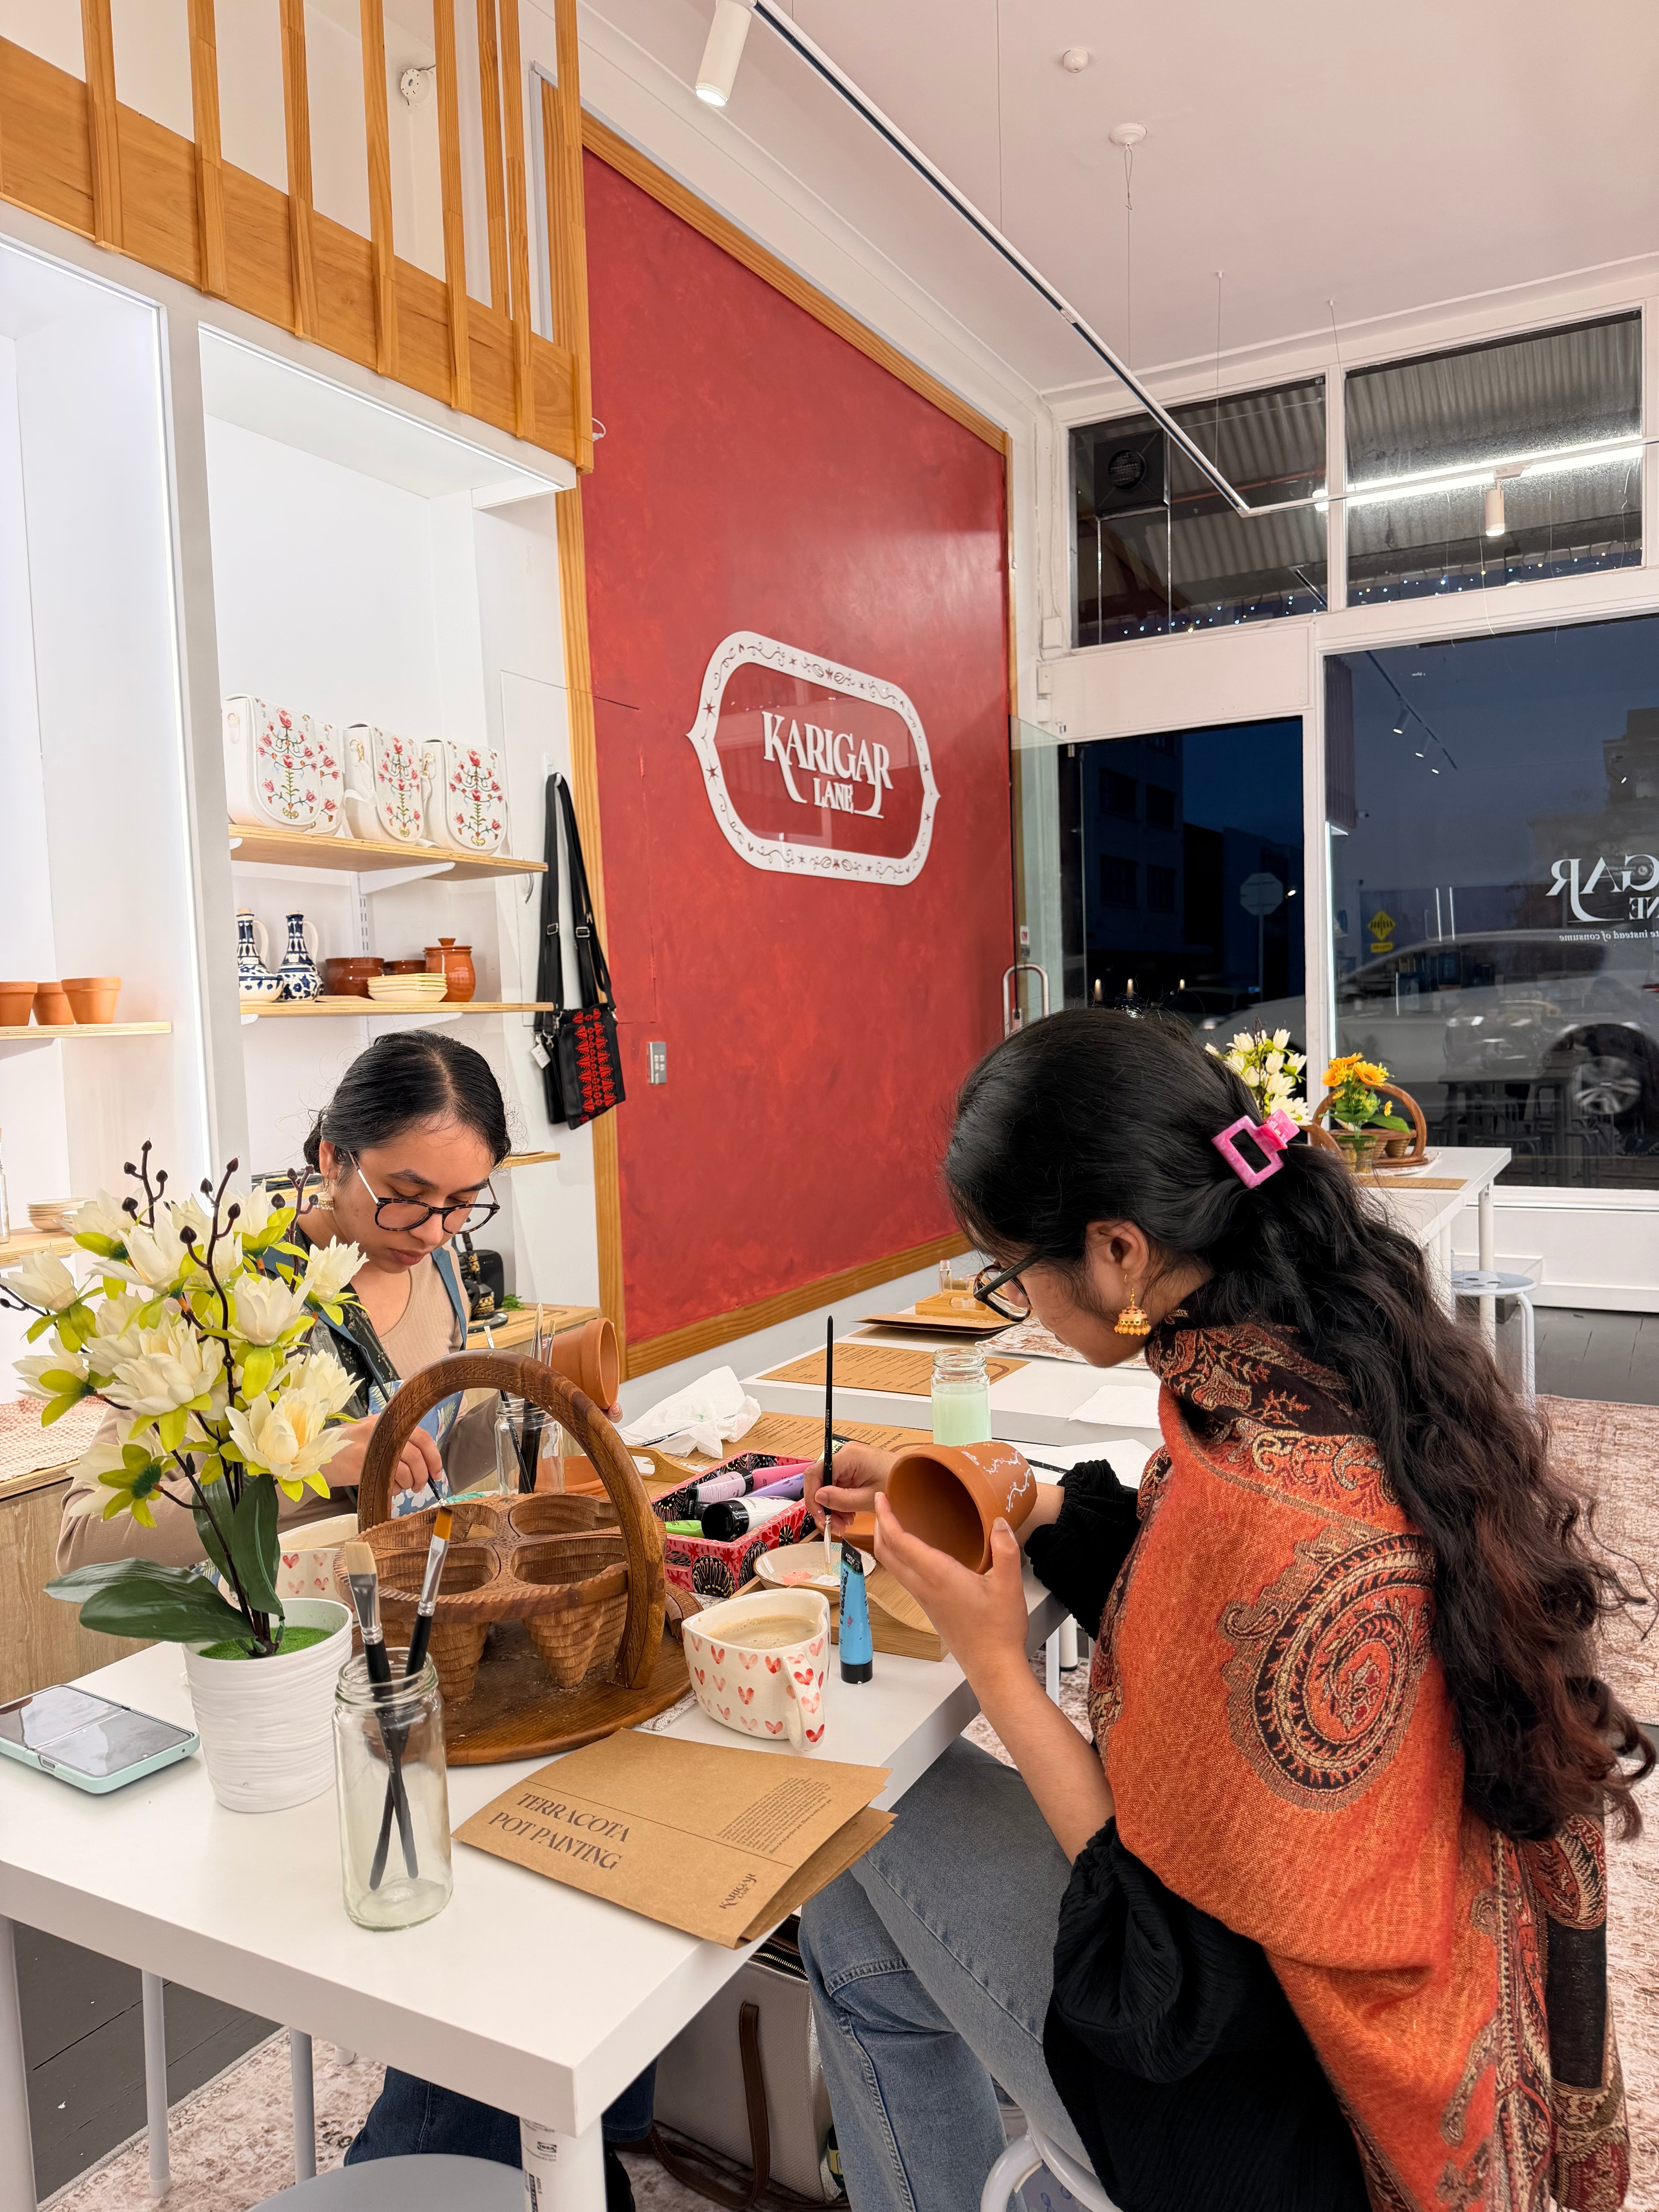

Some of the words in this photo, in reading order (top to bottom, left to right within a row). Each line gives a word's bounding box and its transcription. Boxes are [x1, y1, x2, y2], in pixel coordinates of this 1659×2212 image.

[761, 711, 894, 819] KARIGAR
[813, 778, 854, 814] LANE
[488, 1812, 536, 1836] POT
[529, 1827, 622, 1870] PAINTING
[516, 1793, 630, 1843] TERRACOTA
[719, 1873, 757, 1910] KARIGAR
